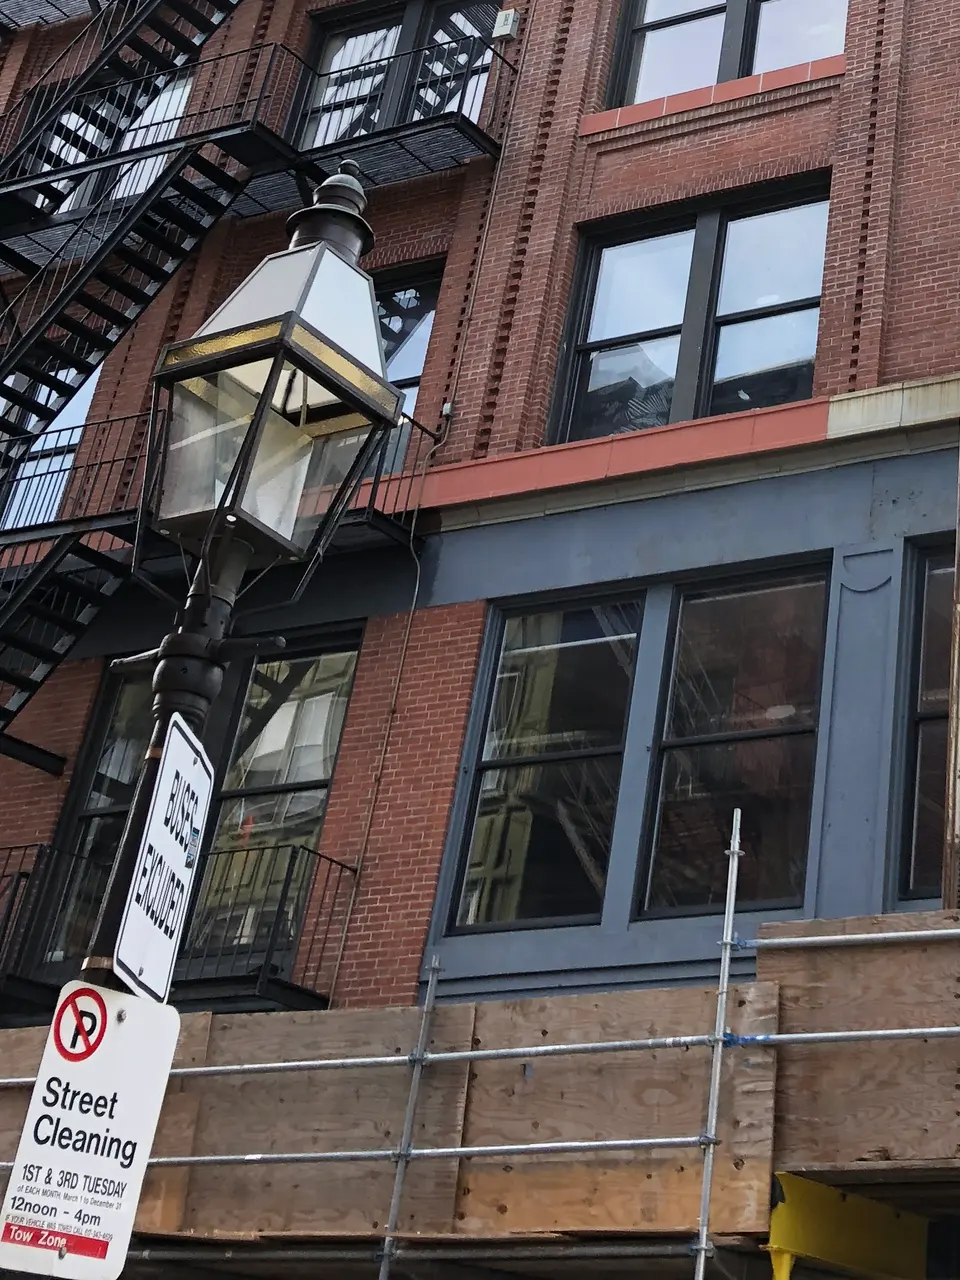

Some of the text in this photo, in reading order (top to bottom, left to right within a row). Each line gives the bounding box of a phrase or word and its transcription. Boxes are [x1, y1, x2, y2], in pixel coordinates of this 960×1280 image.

[164, 769, 199, 853] BUSES
[135, 842, 185, 940] EXCLUDED
[42, 1076, 118, 1119] Street
[33, 1114, 137, 1169] Cleaning
[22, 1164, 127, 1198] 1ST & 3RD TUESDAY
[25, 1185, 40, 1195] EACH
[63, 1192, 78, 1202] March
[90, 1198, 115, 1209] December
[10, 1196, 58, 1218] 12noon
[74, 1209, 101, 1226] 4pm
[11, 1215, 26, 1224] YOUR
[26, 1217, 45, 1228] VEHICLE
[9, 1225, 67, 1248] Tow Zone
